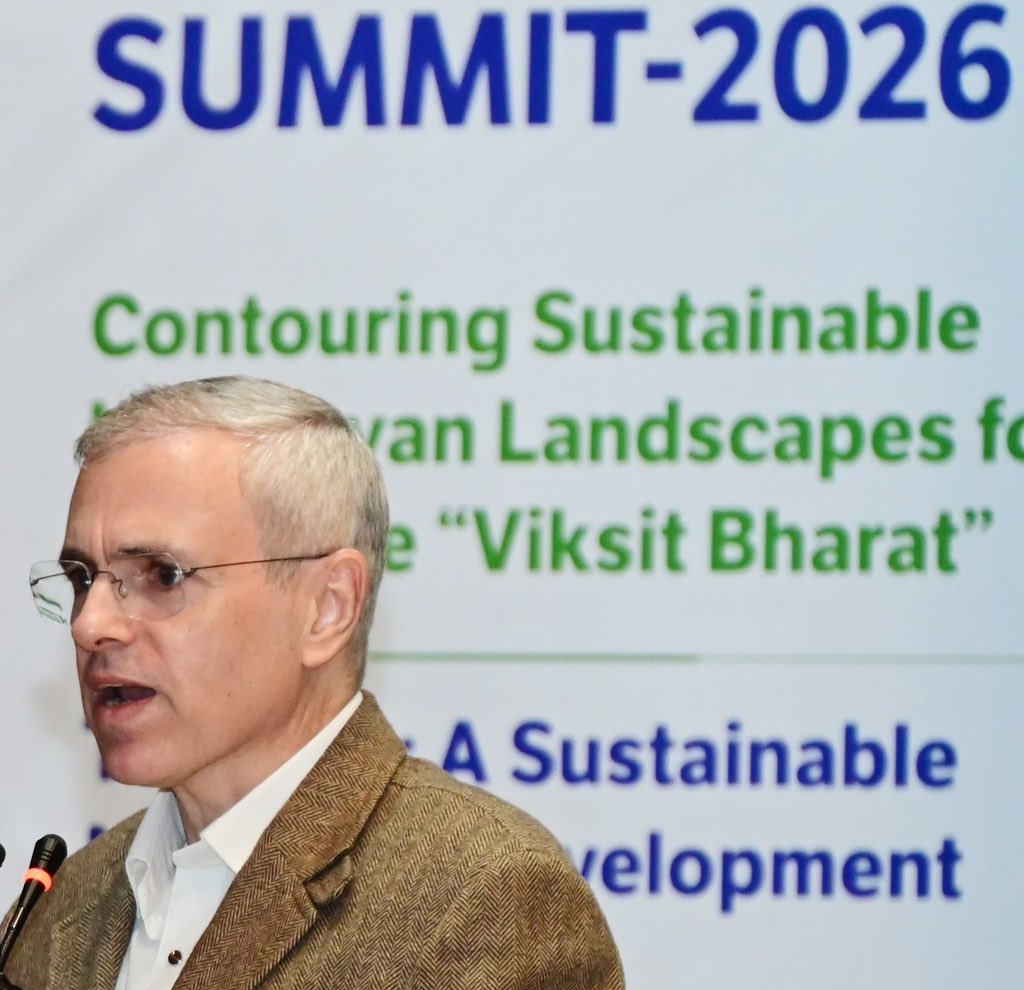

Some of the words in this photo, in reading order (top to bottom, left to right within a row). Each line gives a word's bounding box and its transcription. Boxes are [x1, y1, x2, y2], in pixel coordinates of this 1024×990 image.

[93, 2, 1012, 132] SUMMIT-2026
[92, 290, 509, 371] Contouring
[533, 288, 981, 356] Sustainable
[499, 398, 956, 480] Landscapes
[442, 720, 487, 783] A
[511, 720, 959, 788] Sustainable
